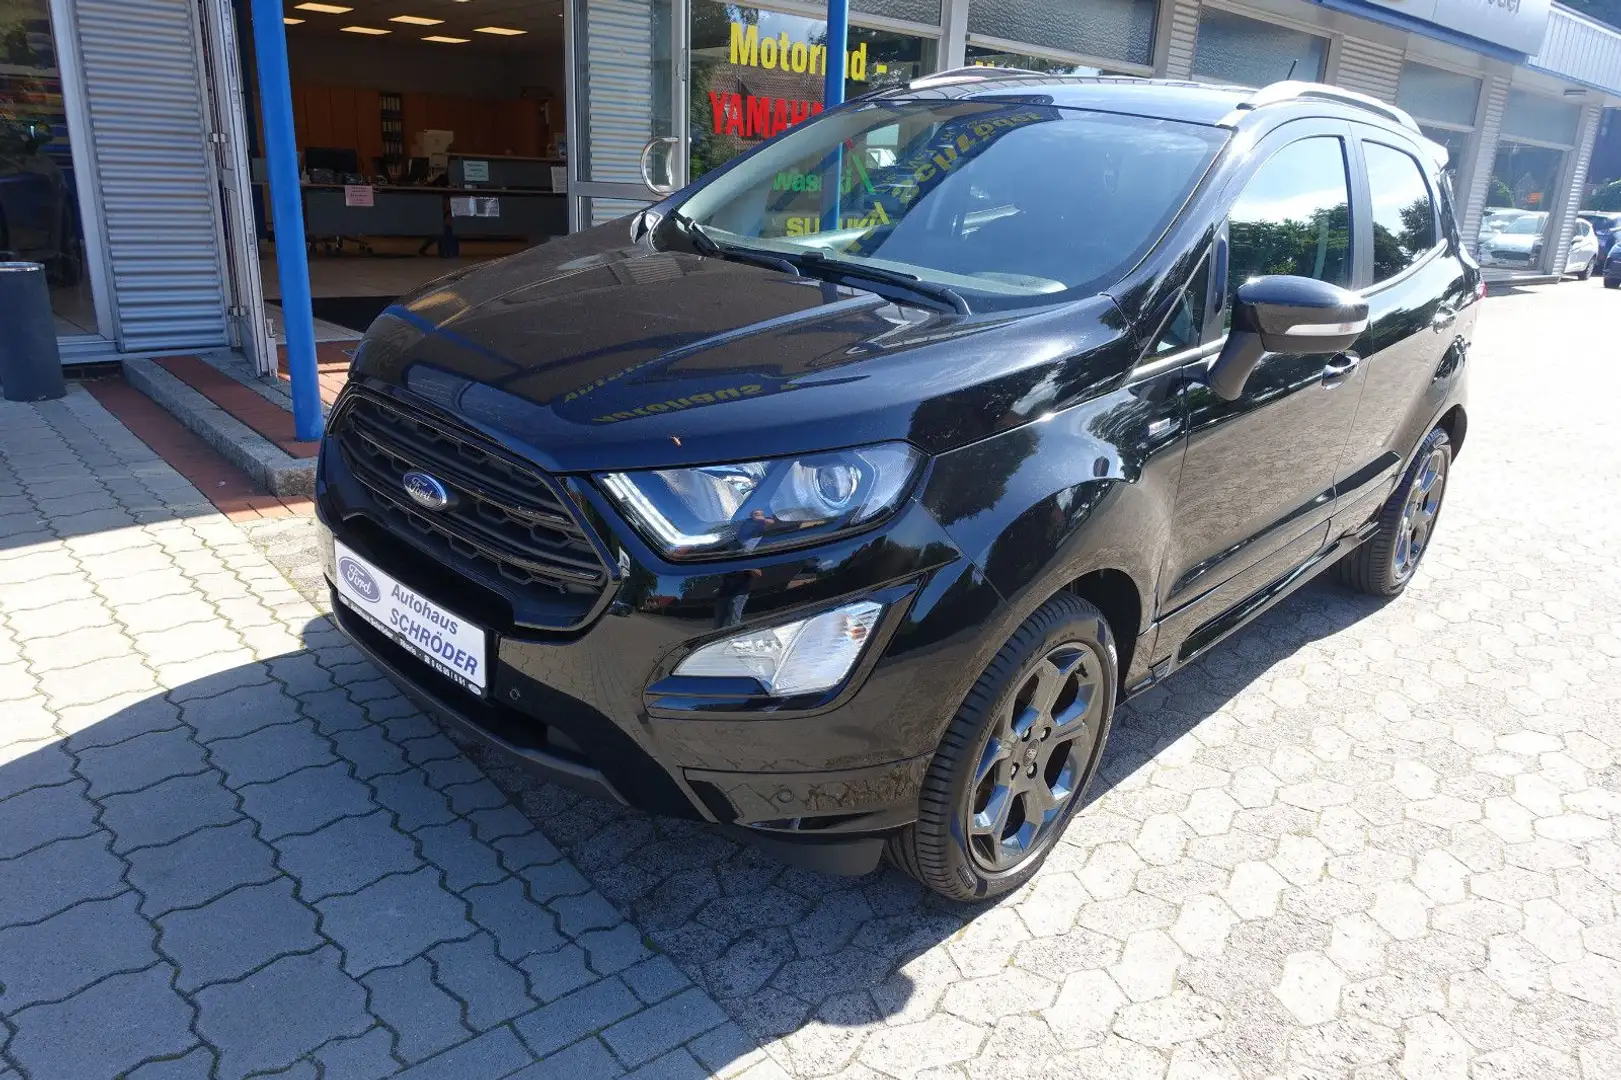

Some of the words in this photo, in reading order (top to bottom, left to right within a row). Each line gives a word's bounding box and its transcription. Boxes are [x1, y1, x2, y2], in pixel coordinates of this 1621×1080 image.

[730, 22, 867, 81] Motord
[708, 90, 824, 138] YAMAH
[786, 214, 874, 237] SUUKI
[347, 564, 373, 596] Ford
[390, 583, 459, 635] Autohaus
[389, 607, 478, 676] SCHRÖDER
